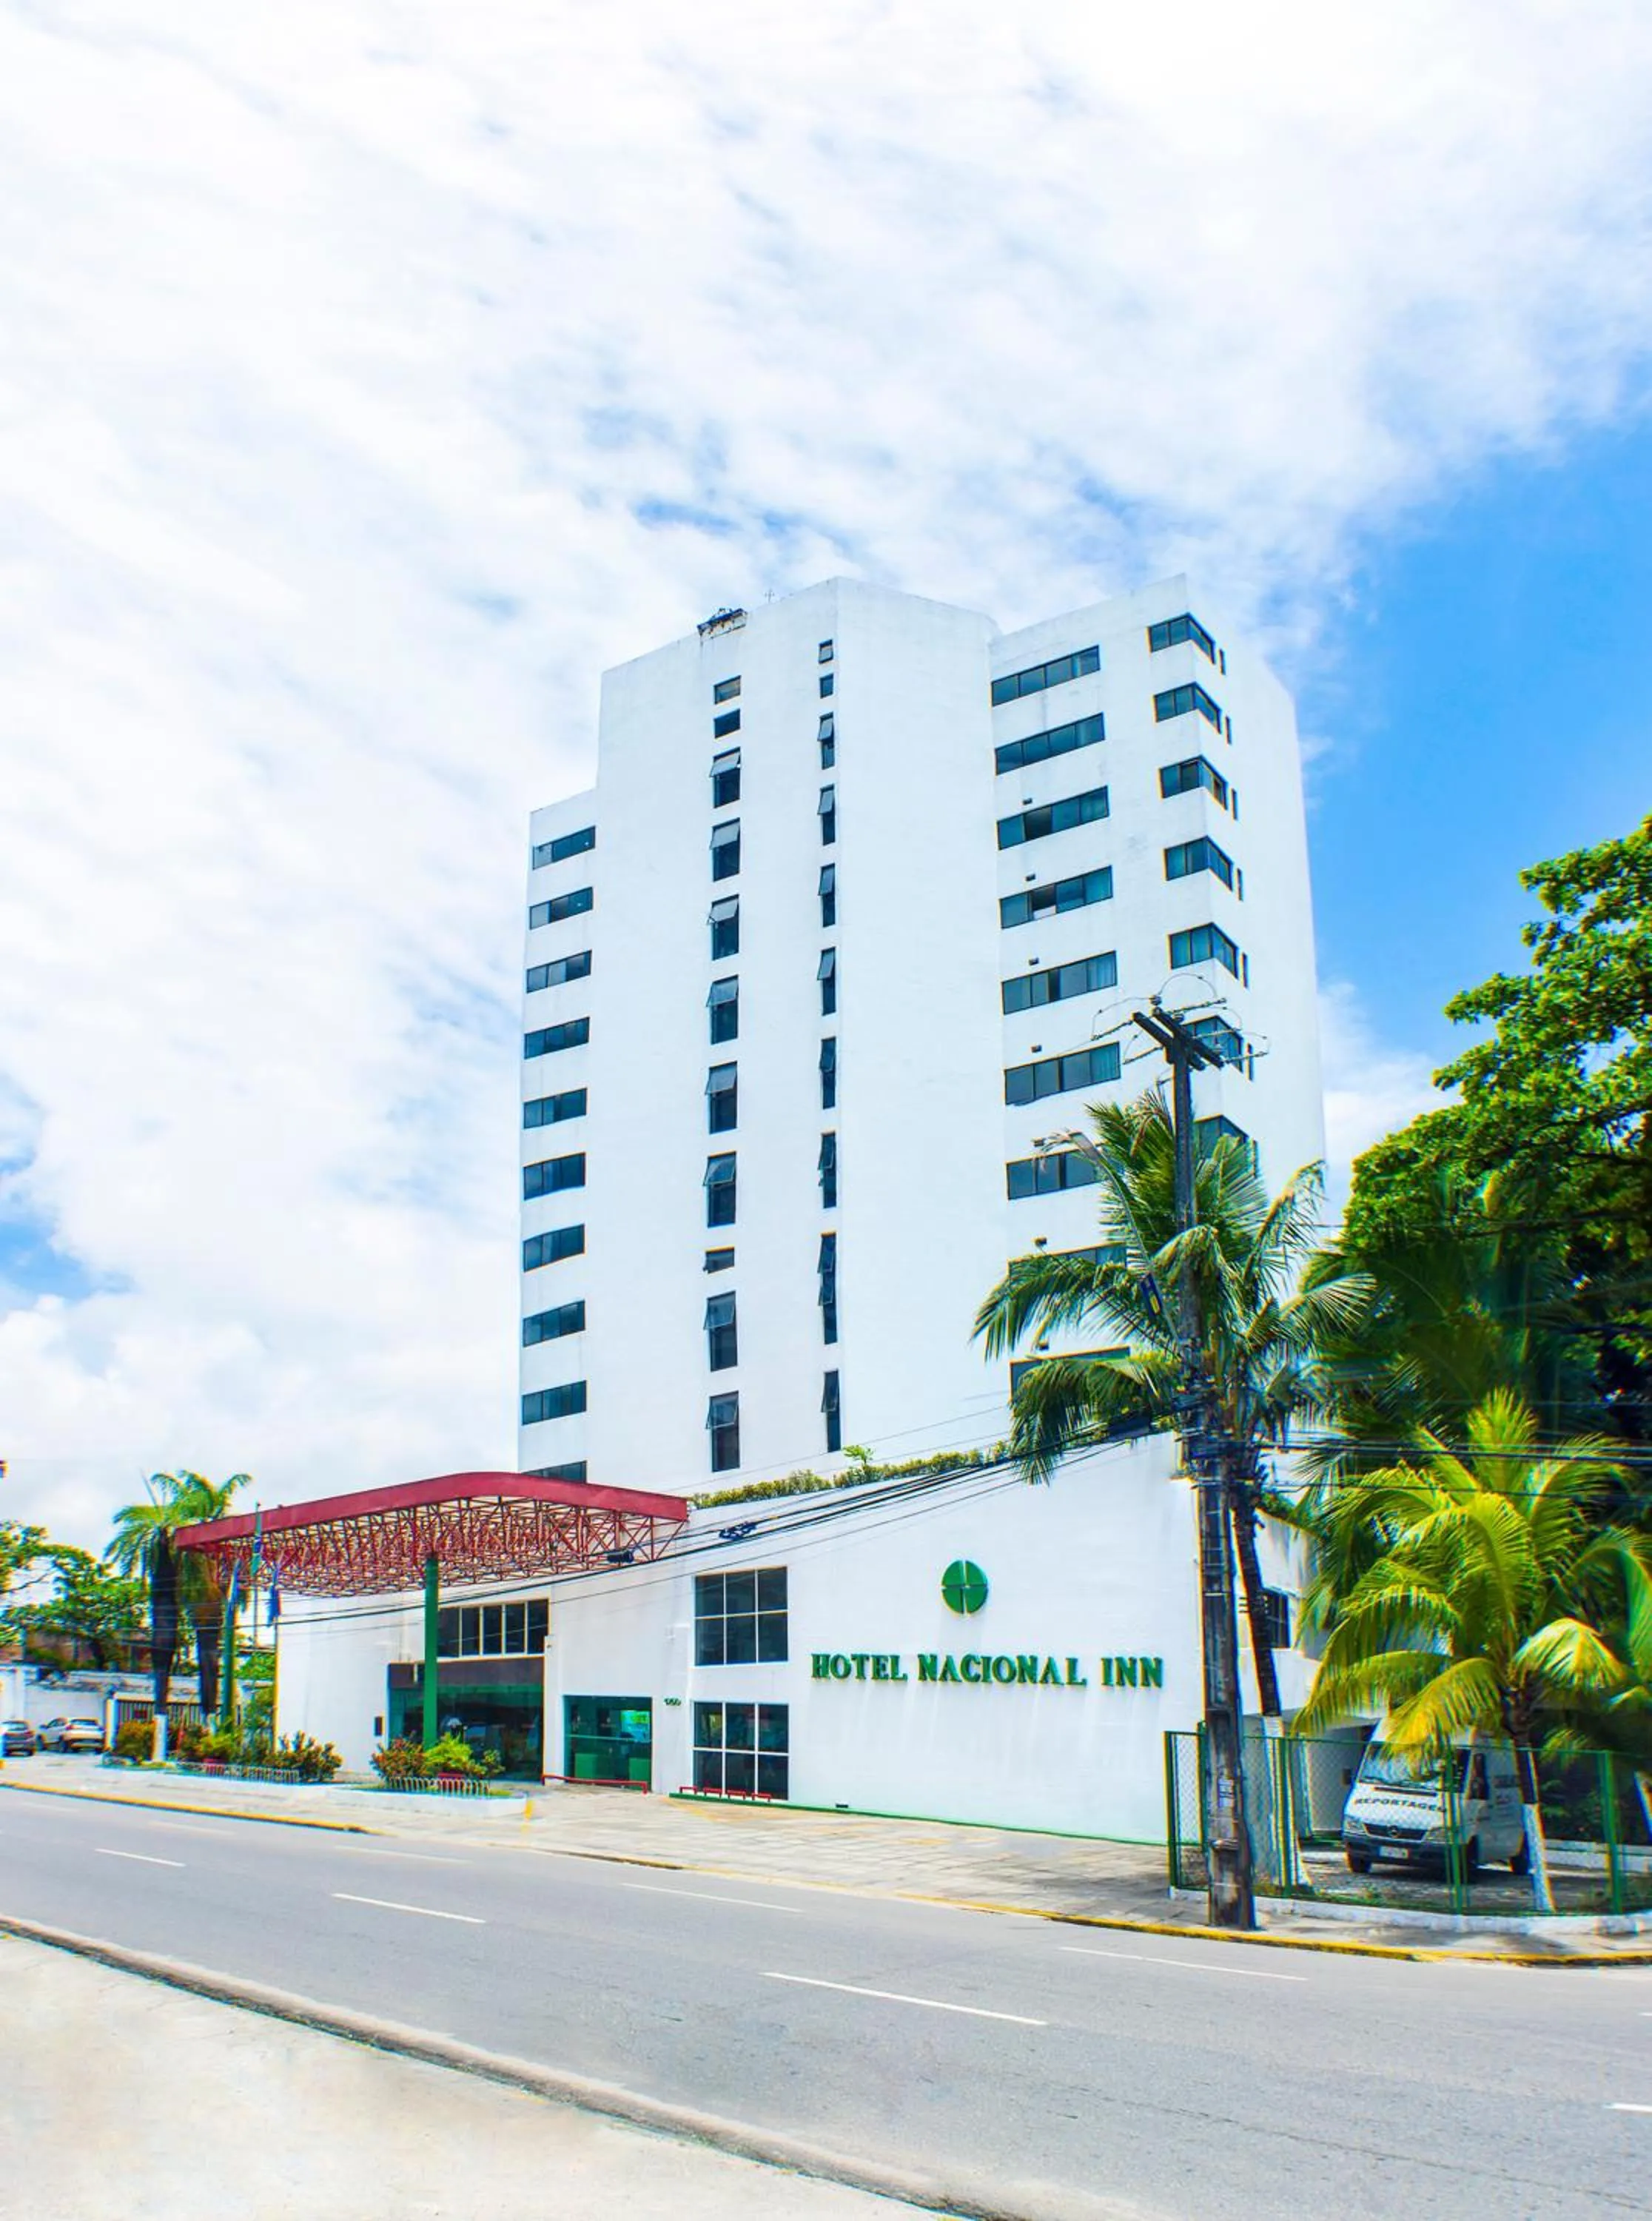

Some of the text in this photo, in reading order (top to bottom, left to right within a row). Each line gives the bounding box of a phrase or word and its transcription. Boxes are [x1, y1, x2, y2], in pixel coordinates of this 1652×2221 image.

[811, 1653, 1164, 1688] HOTEL NACIONAL INN
